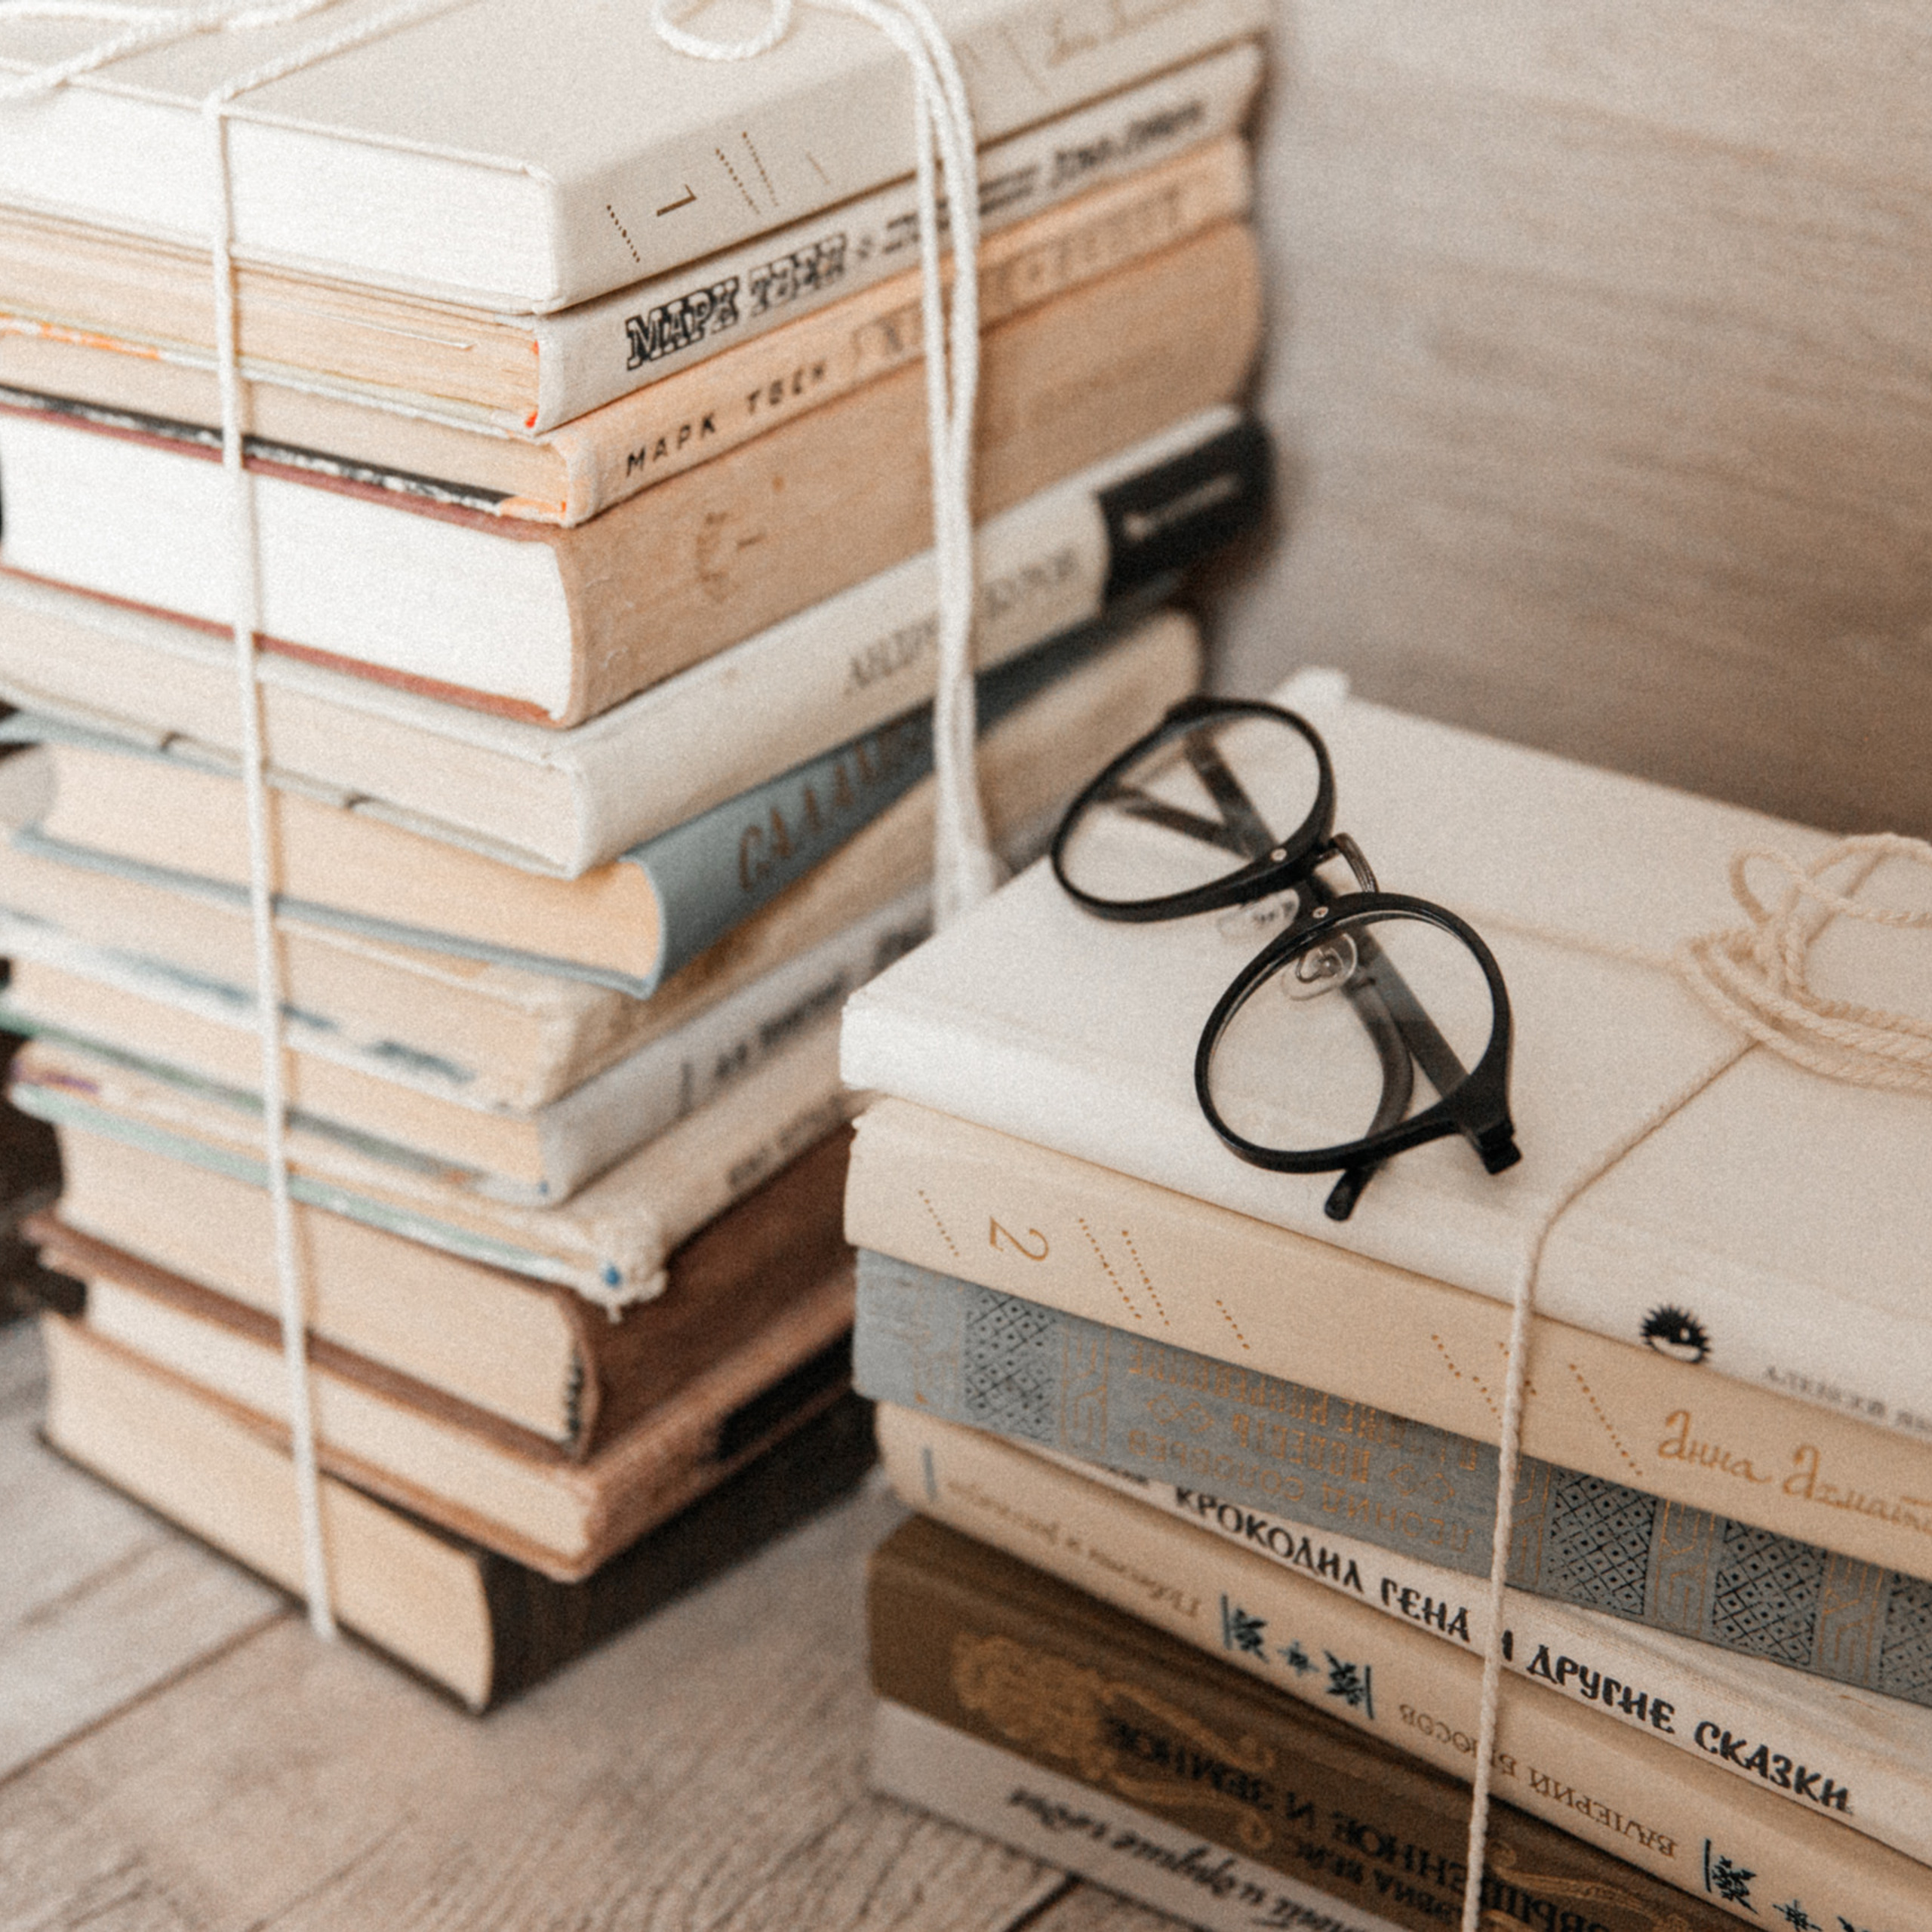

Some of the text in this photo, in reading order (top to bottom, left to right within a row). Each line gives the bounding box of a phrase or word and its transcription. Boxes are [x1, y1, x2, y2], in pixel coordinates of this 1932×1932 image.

[626, 275, 741, 370] МАРК
[626, 416, 717, 477] МАРК
[988, 1215, 1050, 1263] 2
[1231, 1412, 1371, 1485] ПОВЕСТЬ
[1321, 1481, 1475, 1553] ЛЕОНИД
[1380, 1577, 1470, 1643] ГЕНА
[1694, 1720, 1854, 1814] СКАЗКИ
[1398, 1703, 1678, 1860] ВАЛЕРИЙ БЮСОВ
